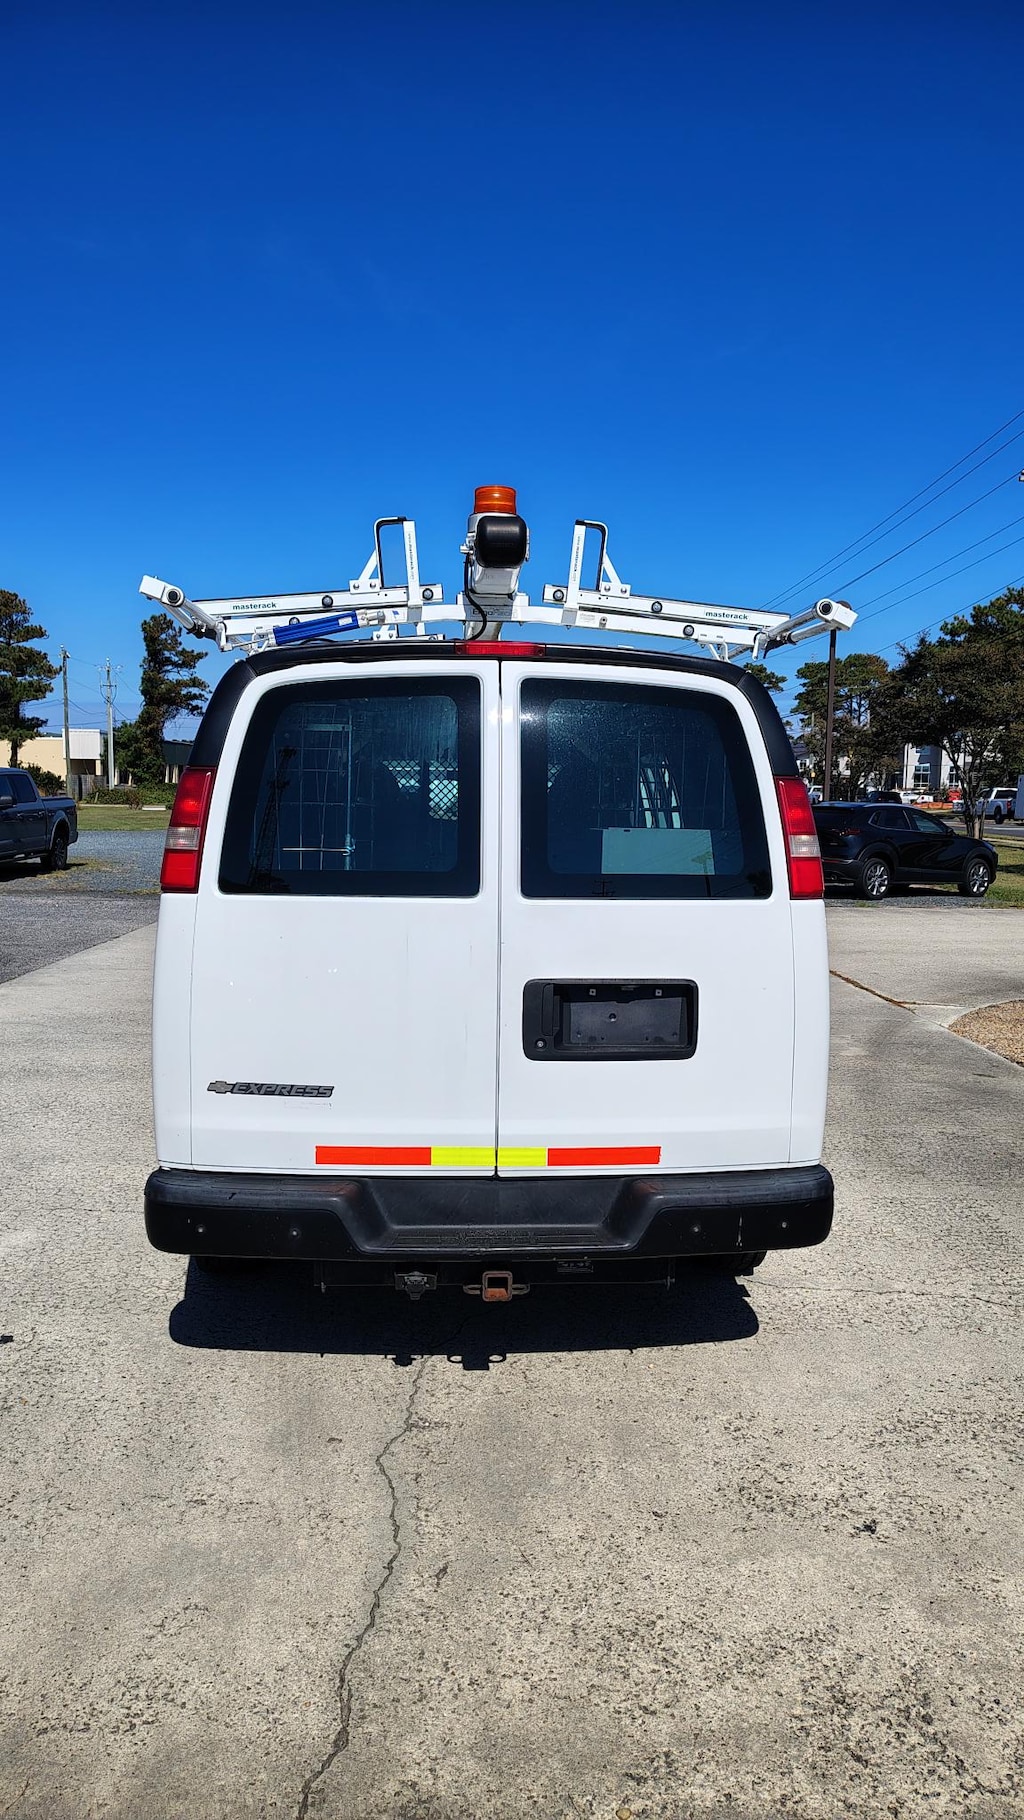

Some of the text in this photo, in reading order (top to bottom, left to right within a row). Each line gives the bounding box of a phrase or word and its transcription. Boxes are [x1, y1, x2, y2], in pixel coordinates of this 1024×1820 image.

[233, 602, 277, 610] masterack
[705, 611, 748, 620] masterack
[233, 1083, 333, 1097] EXPRESS
